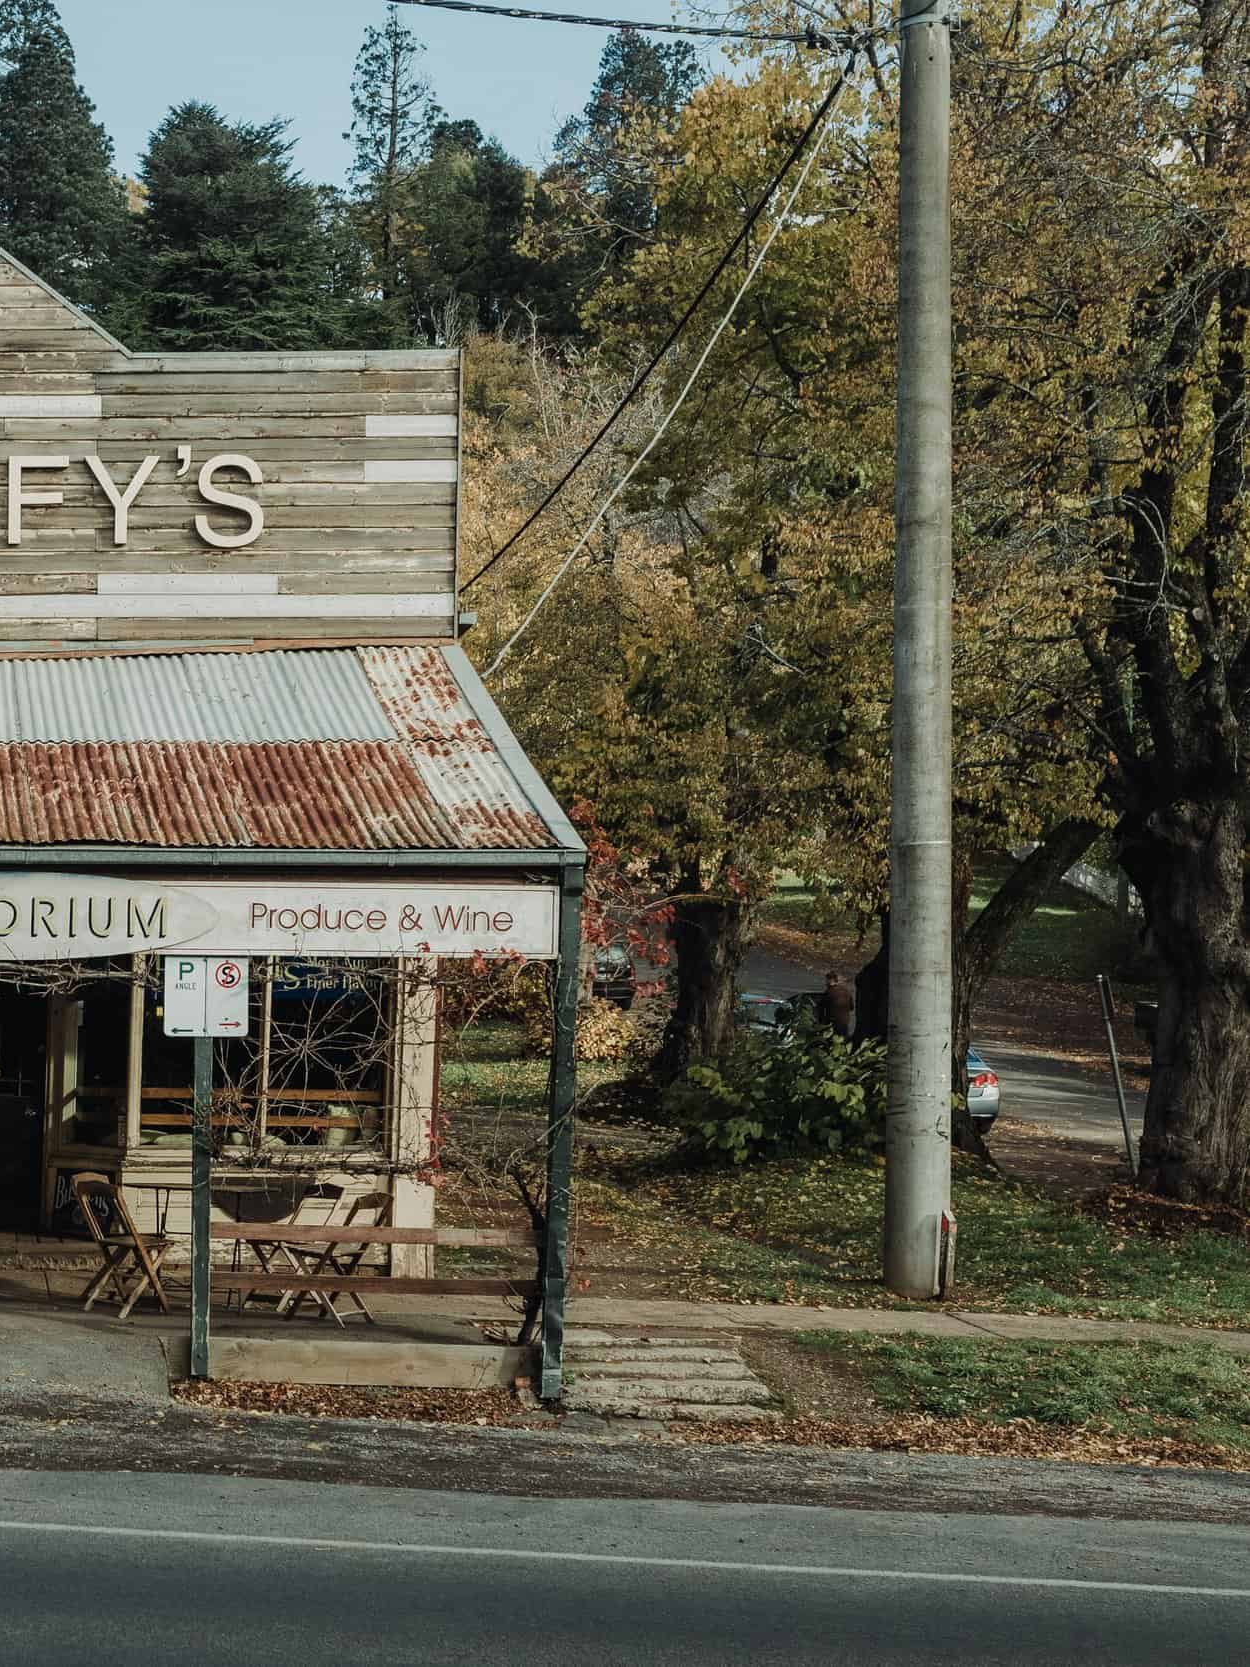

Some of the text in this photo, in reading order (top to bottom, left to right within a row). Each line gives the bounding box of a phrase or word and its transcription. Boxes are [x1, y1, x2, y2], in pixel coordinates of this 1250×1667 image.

[250, 902, 515, 933] Produce & Wine
[179, 961, 194, 981] P
[175, 982, 198, 991] ANGLE
